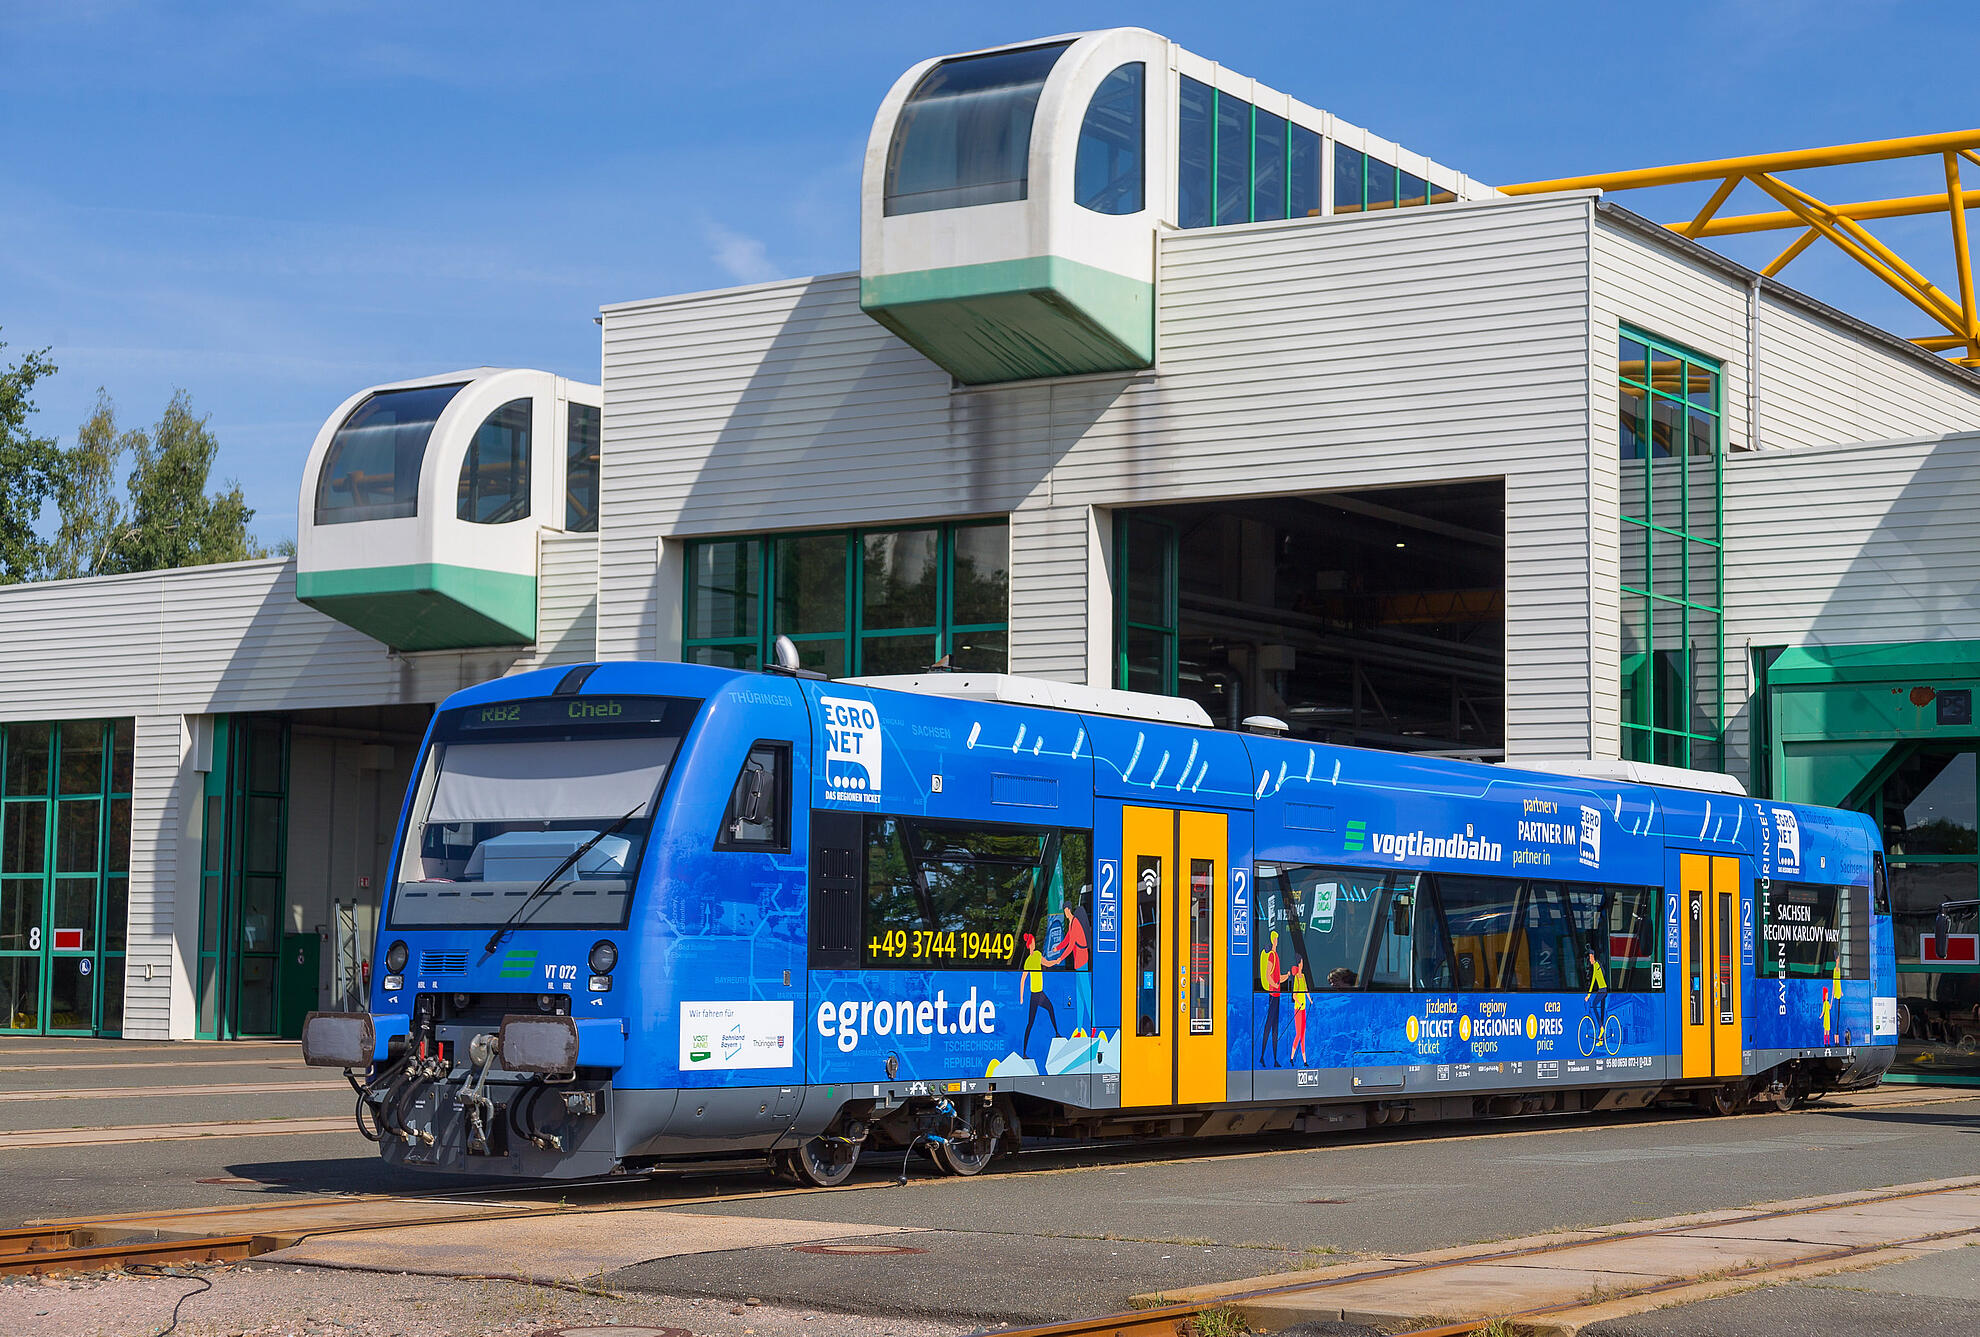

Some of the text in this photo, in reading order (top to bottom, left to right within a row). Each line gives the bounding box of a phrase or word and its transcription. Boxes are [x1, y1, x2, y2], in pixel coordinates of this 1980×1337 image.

[728, 690, 792, 707] THÜRINGEN
[481, 700, 622, 722] RB2 Cheb
[826, 704, 875, 730] EGRO
[911, 724, 951, 739] SACHSEN
[827, 729, 863, 754] NET
[825, 790, 836, 800] DAS
[1523, 796, 1558, 816] partner v
[1518, 820, 1576, 845] PARTNER IM
[1372, 831, 1502, 862] vogtlandbahn
[1513, 848, 1551, 868] partner in
[1754, 803, 1770, 919] THÜRINGEN
[1840, 860, 1864, 874] Sachsen
[1101, 863, 1114, 898] 2
[1234, 872, 1246, 904] 2
[1668, 897, 1677, 923] 2
[1743, 901, 1751, 927] 2
[1778, 904, 1811, 922] SACHSEN
[29, 926, 41, 950] 8
[1763, 924, 1840, 942] REGION KARLOVY VARY
[869, 930, 1014, 960] +49 3744 19449
[545, 965, 577, 979] VT 072
[1778, 943, 1786, 1015] BAYERN
[689, 1008, 734, 1018] Wir fahren für
[1425, 998, 1457, 1018] jízdenka
[1480, 999, 1507, 1017] regiony
[1544, 1002, 1561, 1012] cena
[817, 986, 996, 1052] egronet.de
[1410, 1019, 1454, 1038] 1 TICKET
[1462, 1019, 1522, 1037] 4 REGIONEN
[1529, 1018, 1564, 1035] 1 PREIS
[753, 1039, 776, 1049] Thüringen
[944, 1041, 1005, 1051] TSCHECHISCHE
[1418, 1039, 1440, 1054] ticket
[1471, 1038, 1498, 1057] regions
[1536, 1037, 1554, 1055] price
[944, 1057, 983, 1068] REPUBLIK
[1606, 1059, 1611, 1068] 95
